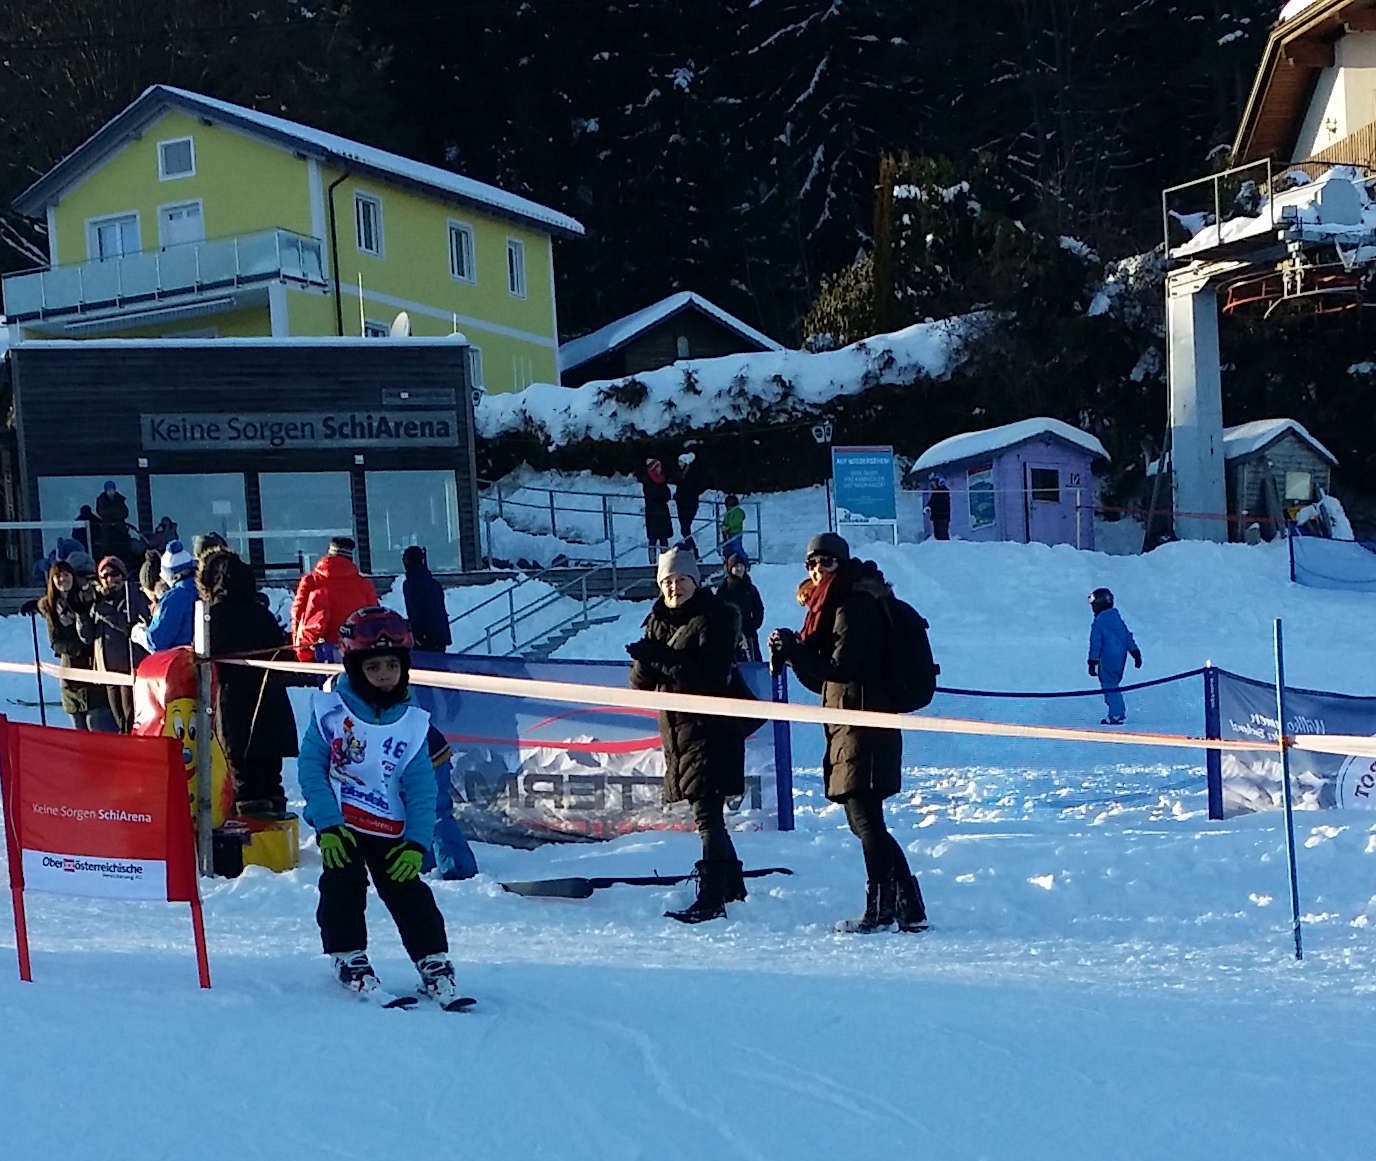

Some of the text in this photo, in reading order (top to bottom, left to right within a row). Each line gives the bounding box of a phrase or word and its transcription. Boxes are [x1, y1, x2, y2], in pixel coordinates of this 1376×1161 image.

[151, 415, 450, 447] Keine Sorgen SchiArena
[382, 736, 408, 759] 46
[32, 803, 152, 823] Keine Sorgen SchiArena
